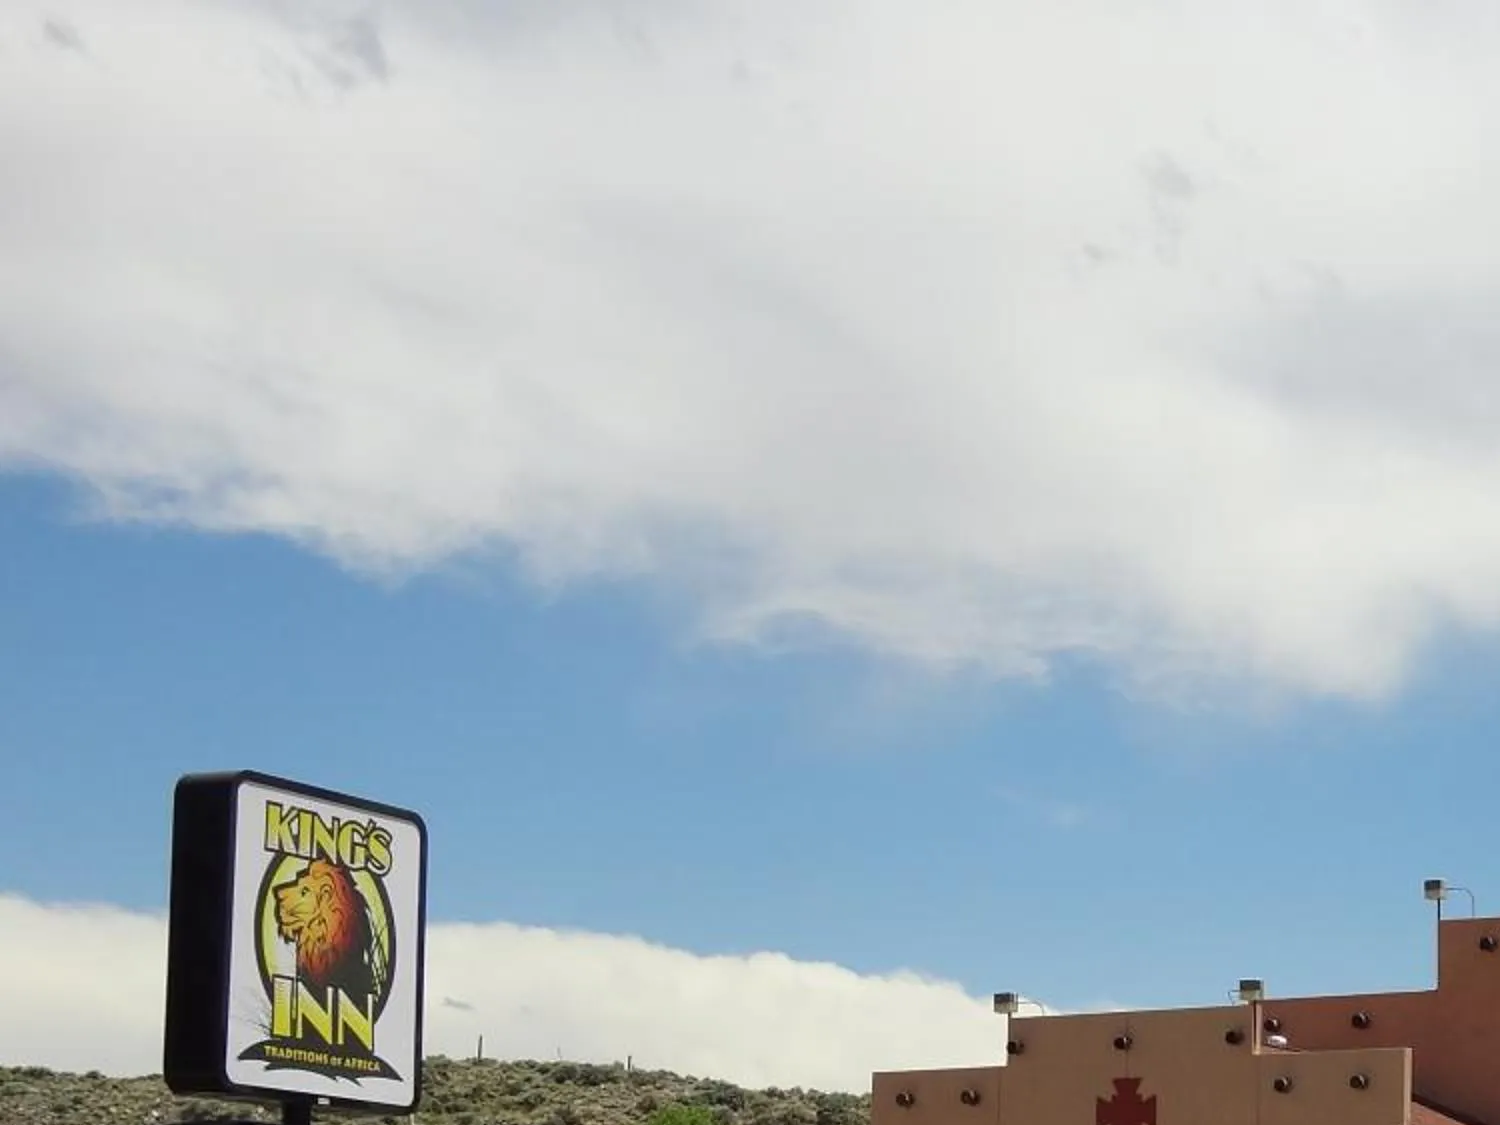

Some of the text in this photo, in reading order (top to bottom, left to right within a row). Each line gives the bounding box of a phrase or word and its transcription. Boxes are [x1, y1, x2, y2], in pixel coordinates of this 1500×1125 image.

[264, 800, 393, 877] KING'S
[271, 974, 375, 1050] INN
[263, 1045, 329, 1066] TRADITIONS
[343, 1058, 381, 1073] AFRICA
